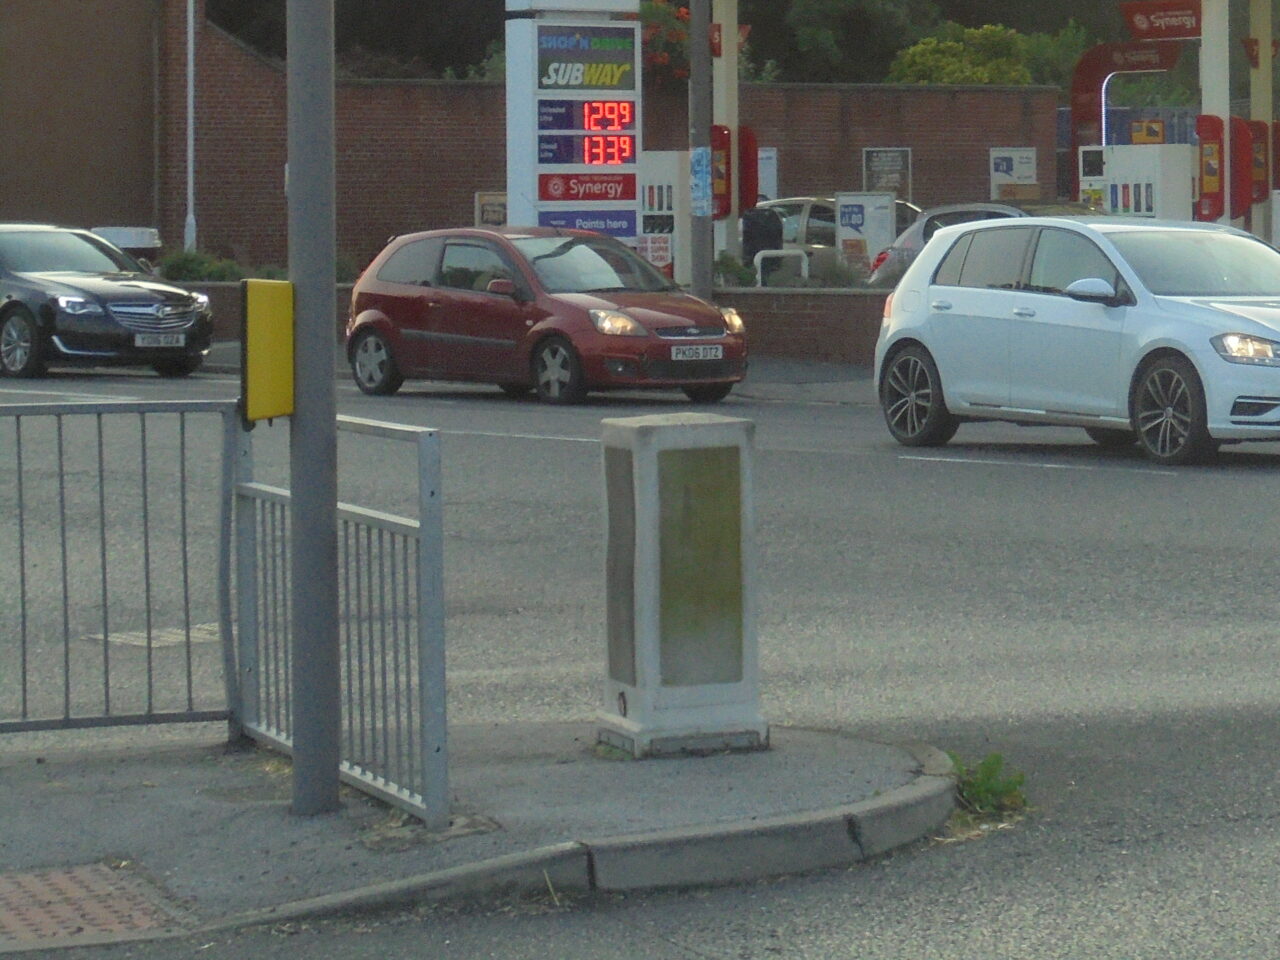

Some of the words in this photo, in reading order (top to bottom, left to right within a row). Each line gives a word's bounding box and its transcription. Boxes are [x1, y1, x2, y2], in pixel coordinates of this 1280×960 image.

[1150, 15, 1196, 30] Synergy
[541, 62, 631, 86] SUBWAY
[569, 179, 624, 198] Synergy
[575, 219, 605, 229] Points
[606, 219, 628, 229] here
